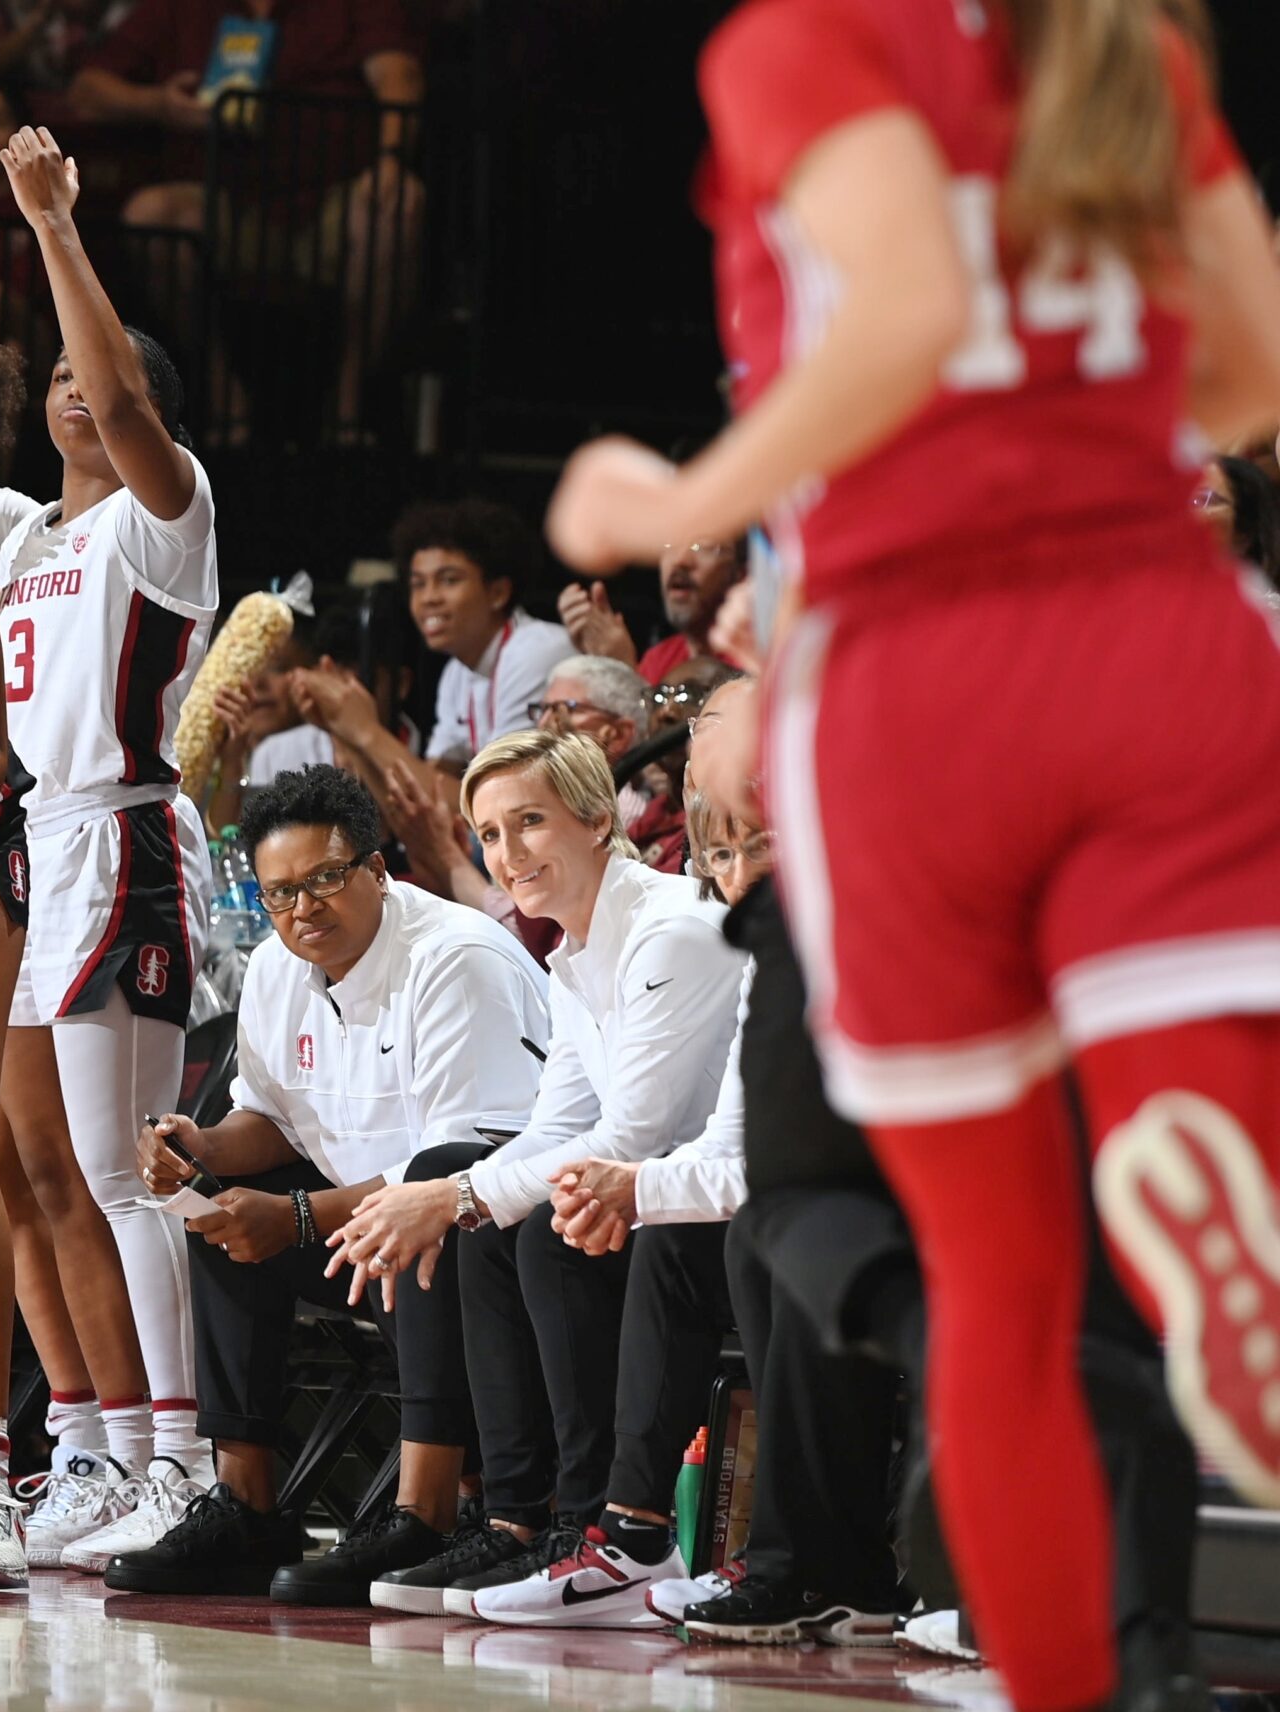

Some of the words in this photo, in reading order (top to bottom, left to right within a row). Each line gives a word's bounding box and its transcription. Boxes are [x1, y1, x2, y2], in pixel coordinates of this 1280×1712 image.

[942, 174, 1148, 388] 14
[6, 618, 35, 703] 3
[713, 1447, 736, 1543] STANFORD
